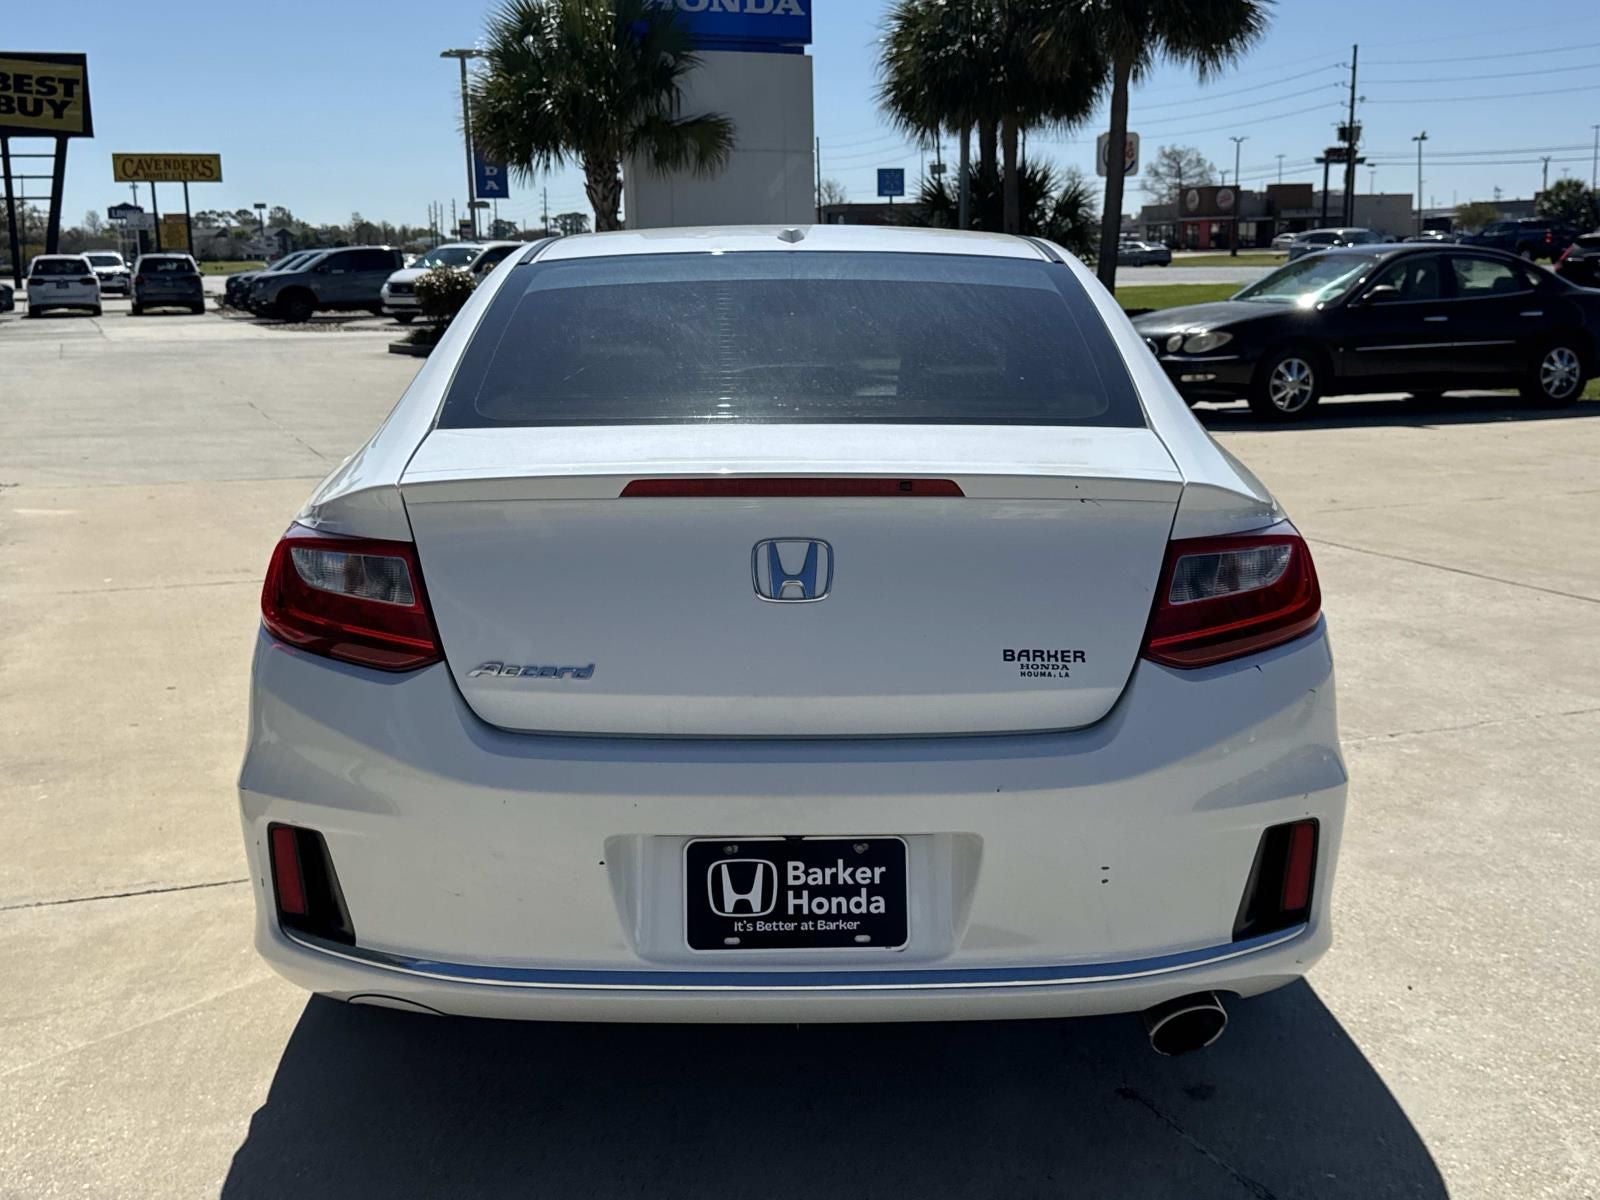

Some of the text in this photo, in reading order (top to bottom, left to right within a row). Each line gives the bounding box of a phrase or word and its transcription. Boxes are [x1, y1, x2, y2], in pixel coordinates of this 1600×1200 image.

[0, 94, 74, 119] BUY
[121, 157, 214, 178] CAVENDER'S
[1003, 649, 1086, 663] BARKER
[466, 661, 595, 680] Accord
[1020, 663, 1070, 671] HONDA
[787, 859, 886, 886] Barker
[787, 888, 886, 915] Honda
[734, 919, 860, 932] It's Better at Barker
